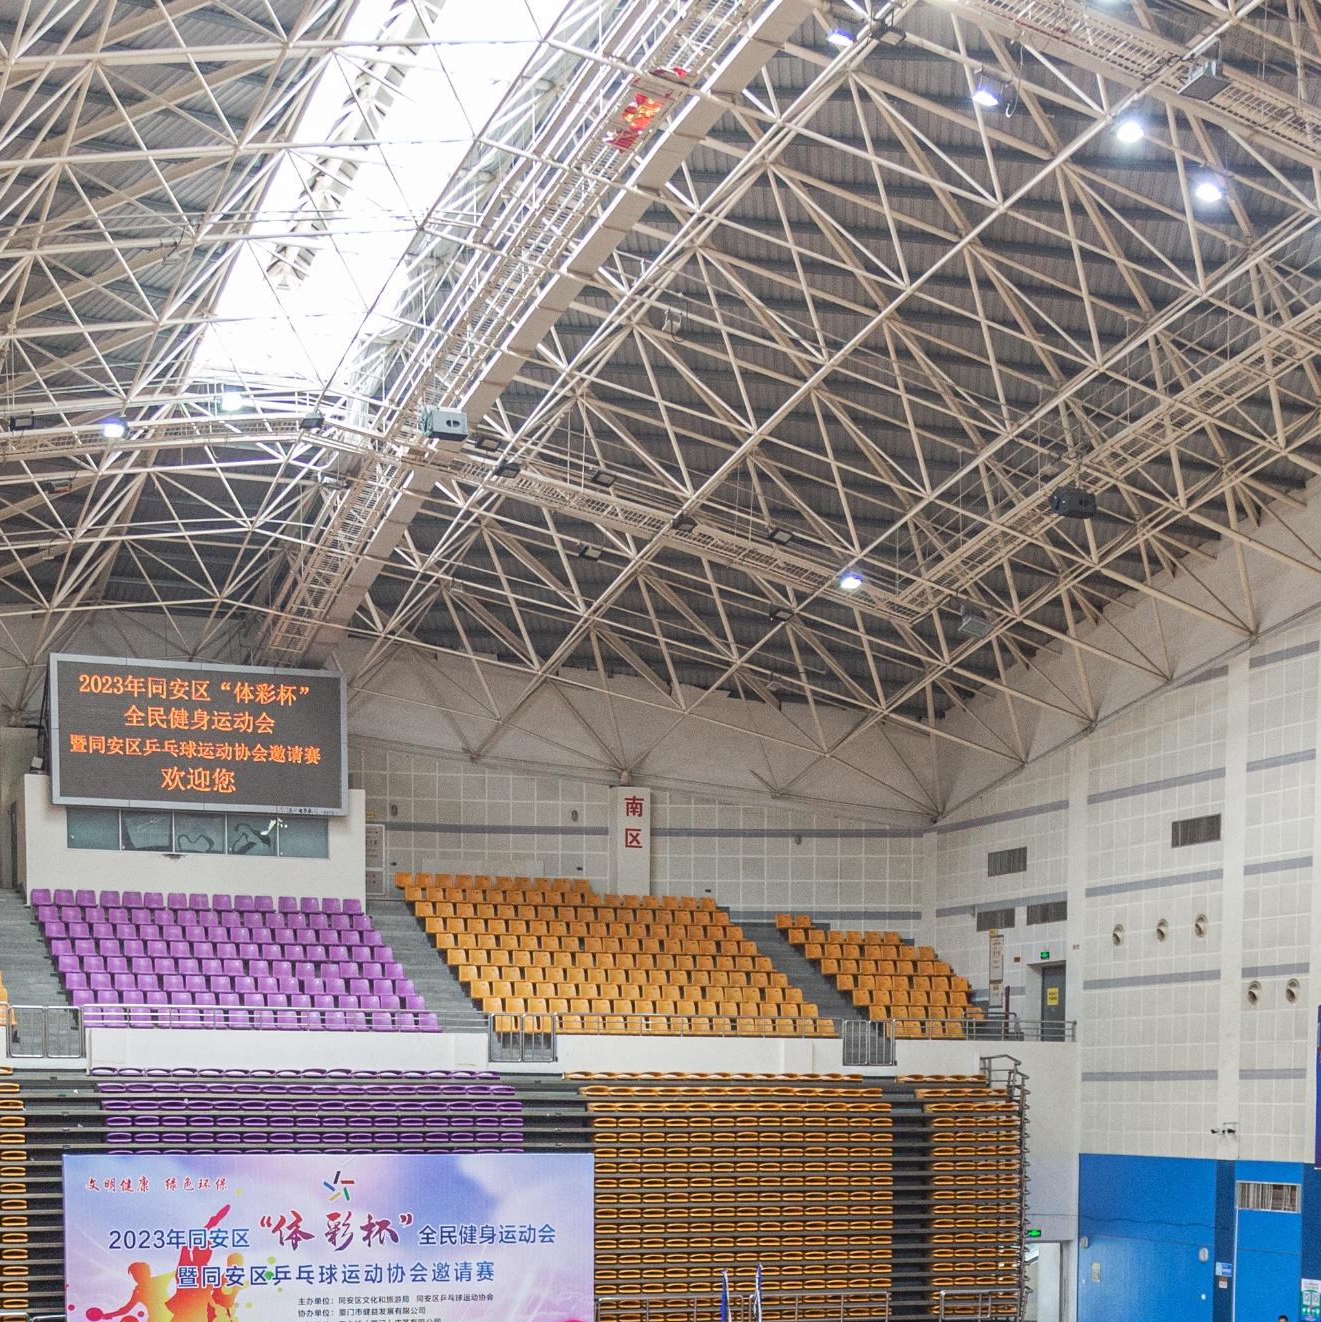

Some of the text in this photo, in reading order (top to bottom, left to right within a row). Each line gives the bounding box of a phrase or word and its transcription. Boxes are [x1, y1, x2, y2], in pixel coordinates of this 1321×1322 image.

[78, 674, 312, 706] 2023年同安区“体彩杯”
[124, 704, 276, 734] 全民健身运动会
[69, 733, 322, 766] 暨同安区乒乓球运动协会邀请赛
[160, 767, 237, 794] 欢迎您
[624, 796, 645, 849] 南区
[178, 1260, 495, 1288] 暨同安区乒乓球运动协会邀请赛
